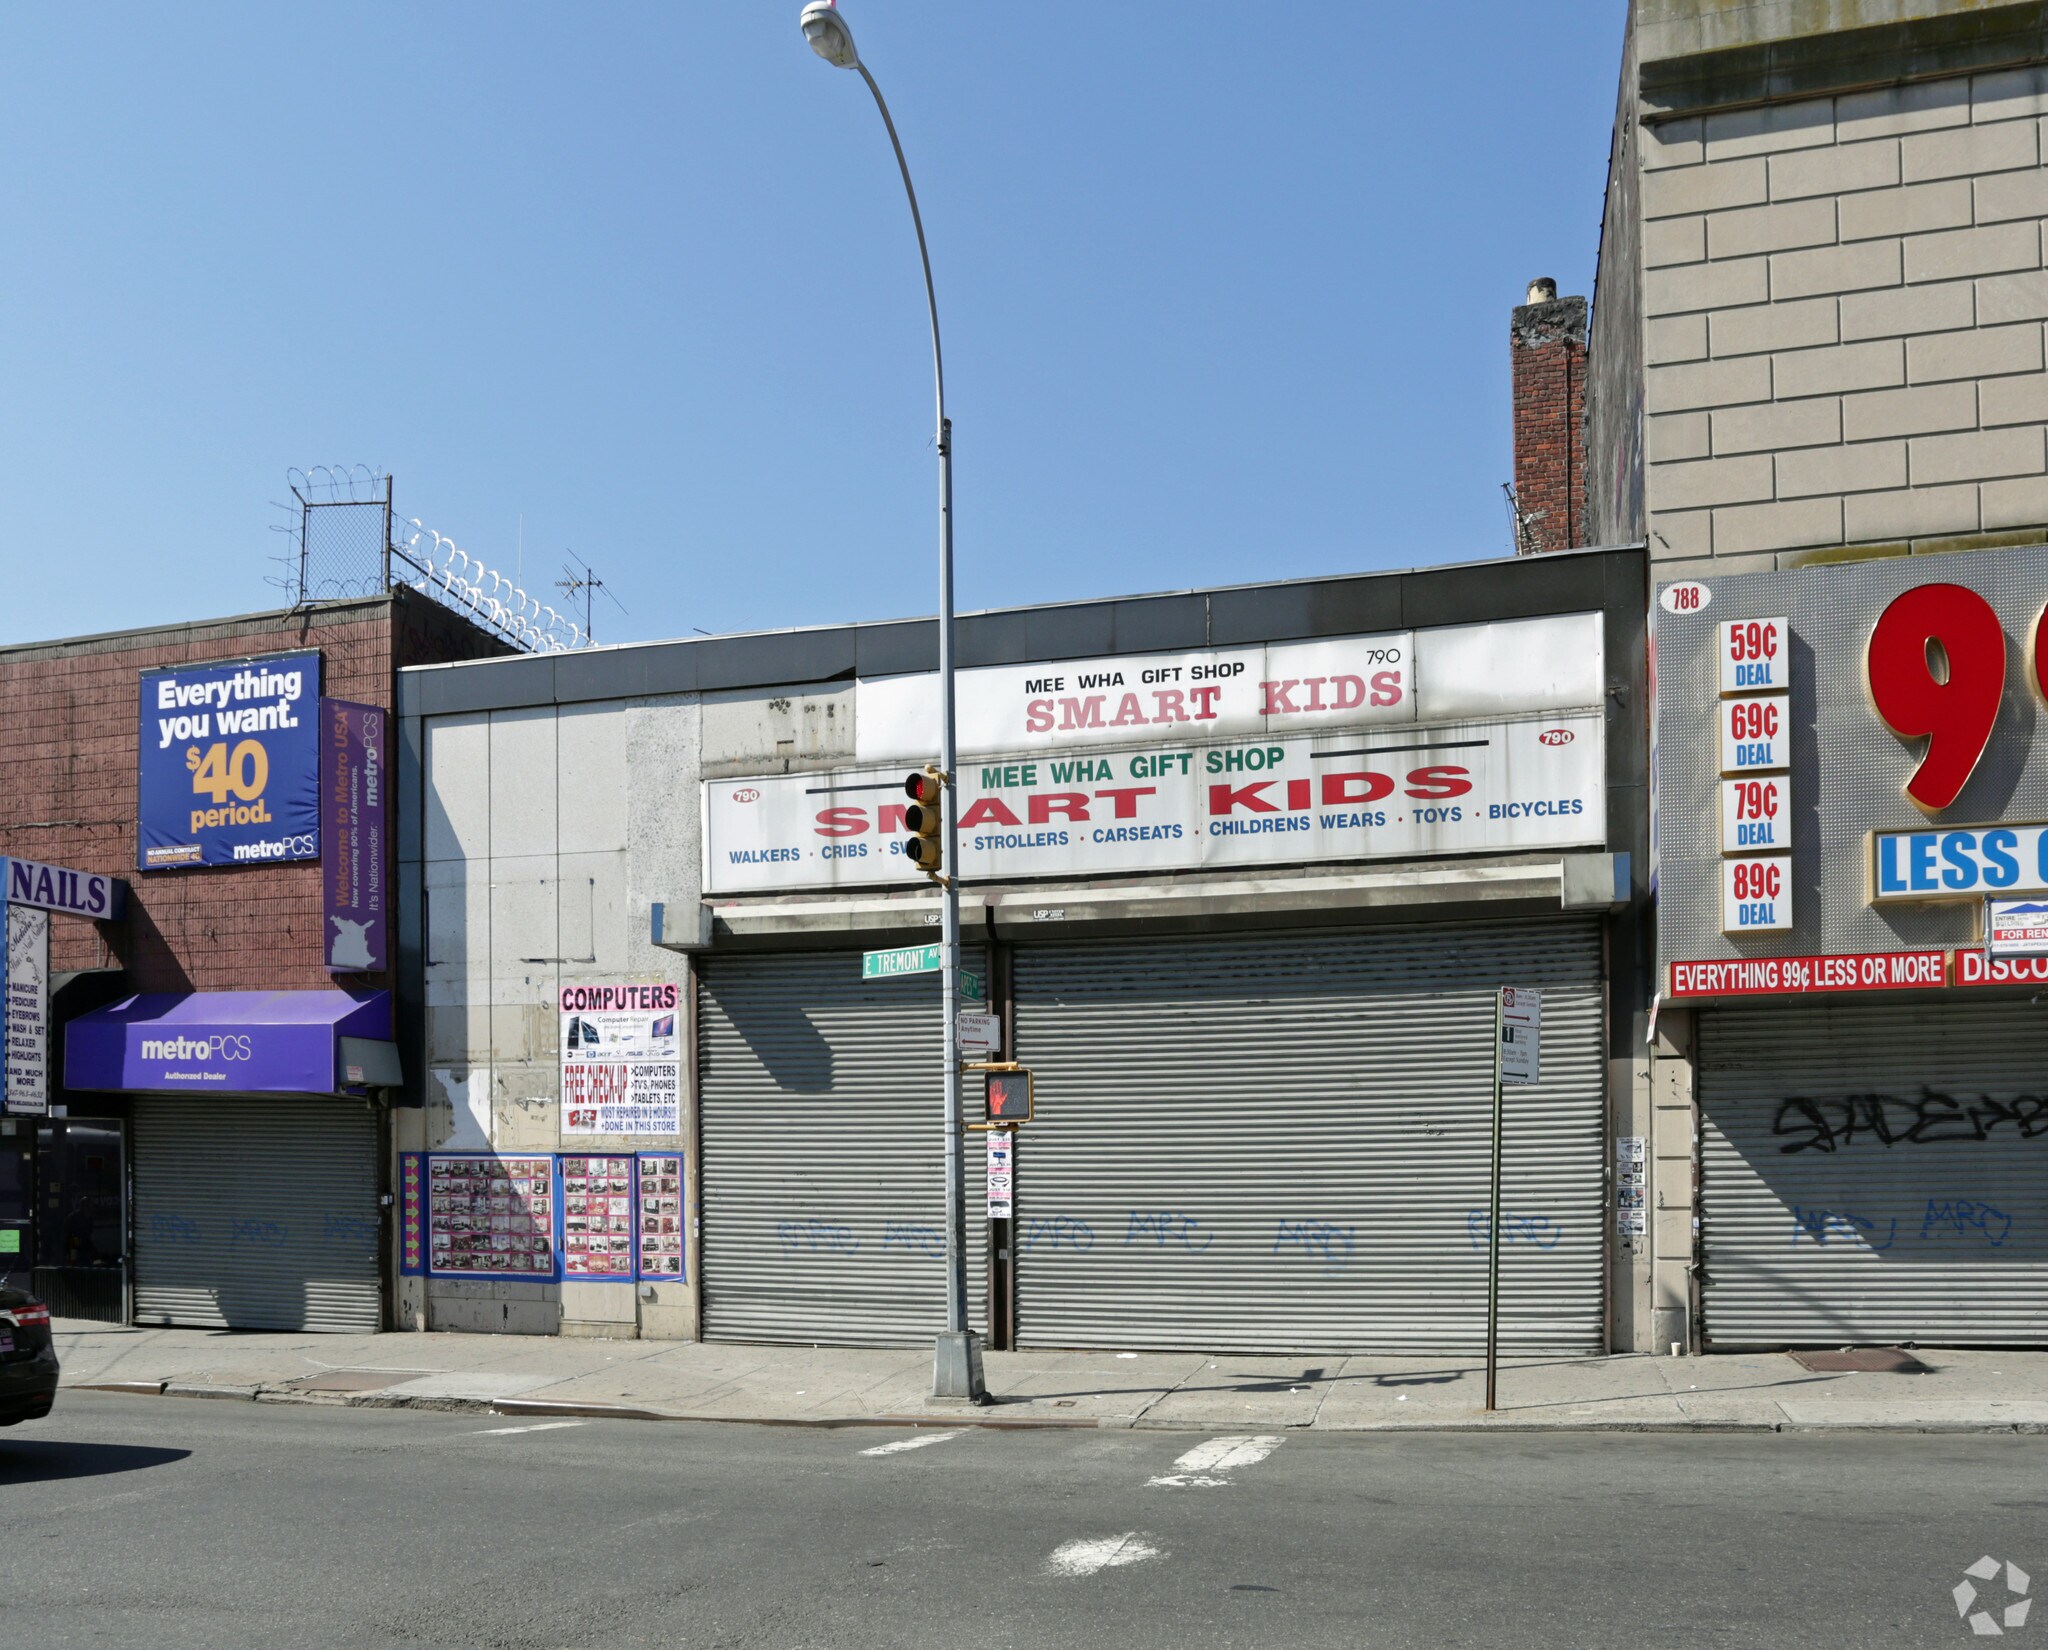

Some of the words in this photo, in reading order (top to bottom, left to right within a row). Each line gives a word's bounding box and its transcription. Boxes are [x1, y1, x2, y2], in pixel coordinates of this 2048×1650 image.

[1673, 587, 1699, 609] 788
[1731, 622, 1777, 661] 59¢
[1366, 649, 1401, 666] 790
[1025, 677, 1064, 694] MEE
[1078, 672, 1125, 689] WHA
[1141, 667, 1183, 684] GIFT
[1191, 662, 1245, 680] SHOP
[1736, 663, 1772, 686] DEAL
[158, 669, 301, 709] Everything
[1868, 583, 2048, 809] 9
[1026, 685, 1221, 733] SMART
[1259, 671, 1403, 716] KIDS
[159, 714, 209, 748] you
[216, 699, 298, 735] want.
[1731, 702, 1778, 740] 69¢
[1543, 731, 1572, 744] 790
[363, 712, 378, 807] metroPCS
[1736, 743, 1773, 766] DEAL
[186, 739, 268, 803] $40
[335, 752, 348, 803] Metro
[982, 765, 1037, 789] MEE
[1050, 759, 1113, 784] WHA
[1129, 753, 1193, 779] GIFT
[1206, 746, 1285, 774] SHOP
[735, 790, 758, 801] 790
[1209, 765, 1473, 815] KIDS
[1734, 781, 1777, 820] 79¢
[191, 799, 272, 833] period.
[336, 808, 348, 826] to
[351, 814, 358, 825] of
[729, 848, 800, 864] WALKERS
[821, 843, 868, 859] CRIBS
[974, 831, 1069, 850] STROLLERS
[1092, 823, 1183, 844] CARSEATS
[1209, 816, 1311, 836] CHILDRENS
[1319, 811, 1386, 829] WEARS
[1412, 806, 1462, 824] TOYS
[1489, 799, 1583, 819] BICYCLES
[1738, 823, 1774, 845] DEAL
[148, 853, 190, 863] NATIONWIDE
[234, 835, 315, 860] metroPCS
[335, 830, 348, 906] Welcome
[351, 850, 359, 888] covering
[1881, 830, 2019, 892] LESS
[11, 861, 105, 913] NAILS
[1734, 863, 1780, 900] 89¢
[369, 895, 378, 910] It's
[1739, 903, 1775, 925] DEAL
[2001, 930, 2024, 939] FOR
[865, 956, 872, 975] E
[878, 949, 925, 973] TREMONT
[928, 947, 938, 959] AV
[1675, 962, 1778, 991] EVERYTHING
[1782, 961, 1810, 992] 99¢
[1814, 959, 1857, 986] LESS
[1861, 957, 1887, 985] OR
[1891, 955, 1941, 983] MORE
[12, 982, 38, 995] MANICURE
[562, 985, 675, 1011] COMPUTERS
[12, 996, 37, 1008] PEDICURE
[12, 1009, 40, 1021] EYEBROWS
[597, 1016, 629, 1024] Computer
[969, 1017, 990, 1025] PARKING
[12, 1023, 26, 1033] WASH
[35, 1026, 45, 1036] SET
[12, 1037, 36, 1048] RELAXER
[141, 1035, 251, 1061] metroPCS
[12, 1050, 41, 1062] HIGHLIGHTS
[9, 1067, 22, 1076] AND
[25, 1068, 43, 1078] MUCH
[16, 1077, 35, 1087] MORE
[164, 1071, 201, 1080] Authorized
[203, 1072, 226, 1080] Dealer
[565, 1065, 584, 1104] FREE
[588, 1065, 628, 1104] CHECK-UP
[650, 1080, 675, 1090] PHONES
[664, 1093, 675, 1103] ETC
[601, 1107, 615, 1119] MOST
[617, 1107, 640, 1119] REPAIRED
[642, 1107, 648, 1118] IN
[626, 1121, 633, 1130] IN
[635, 1121, 651, 1131] THIS
[653, 1121, 675, 1131] STORE
